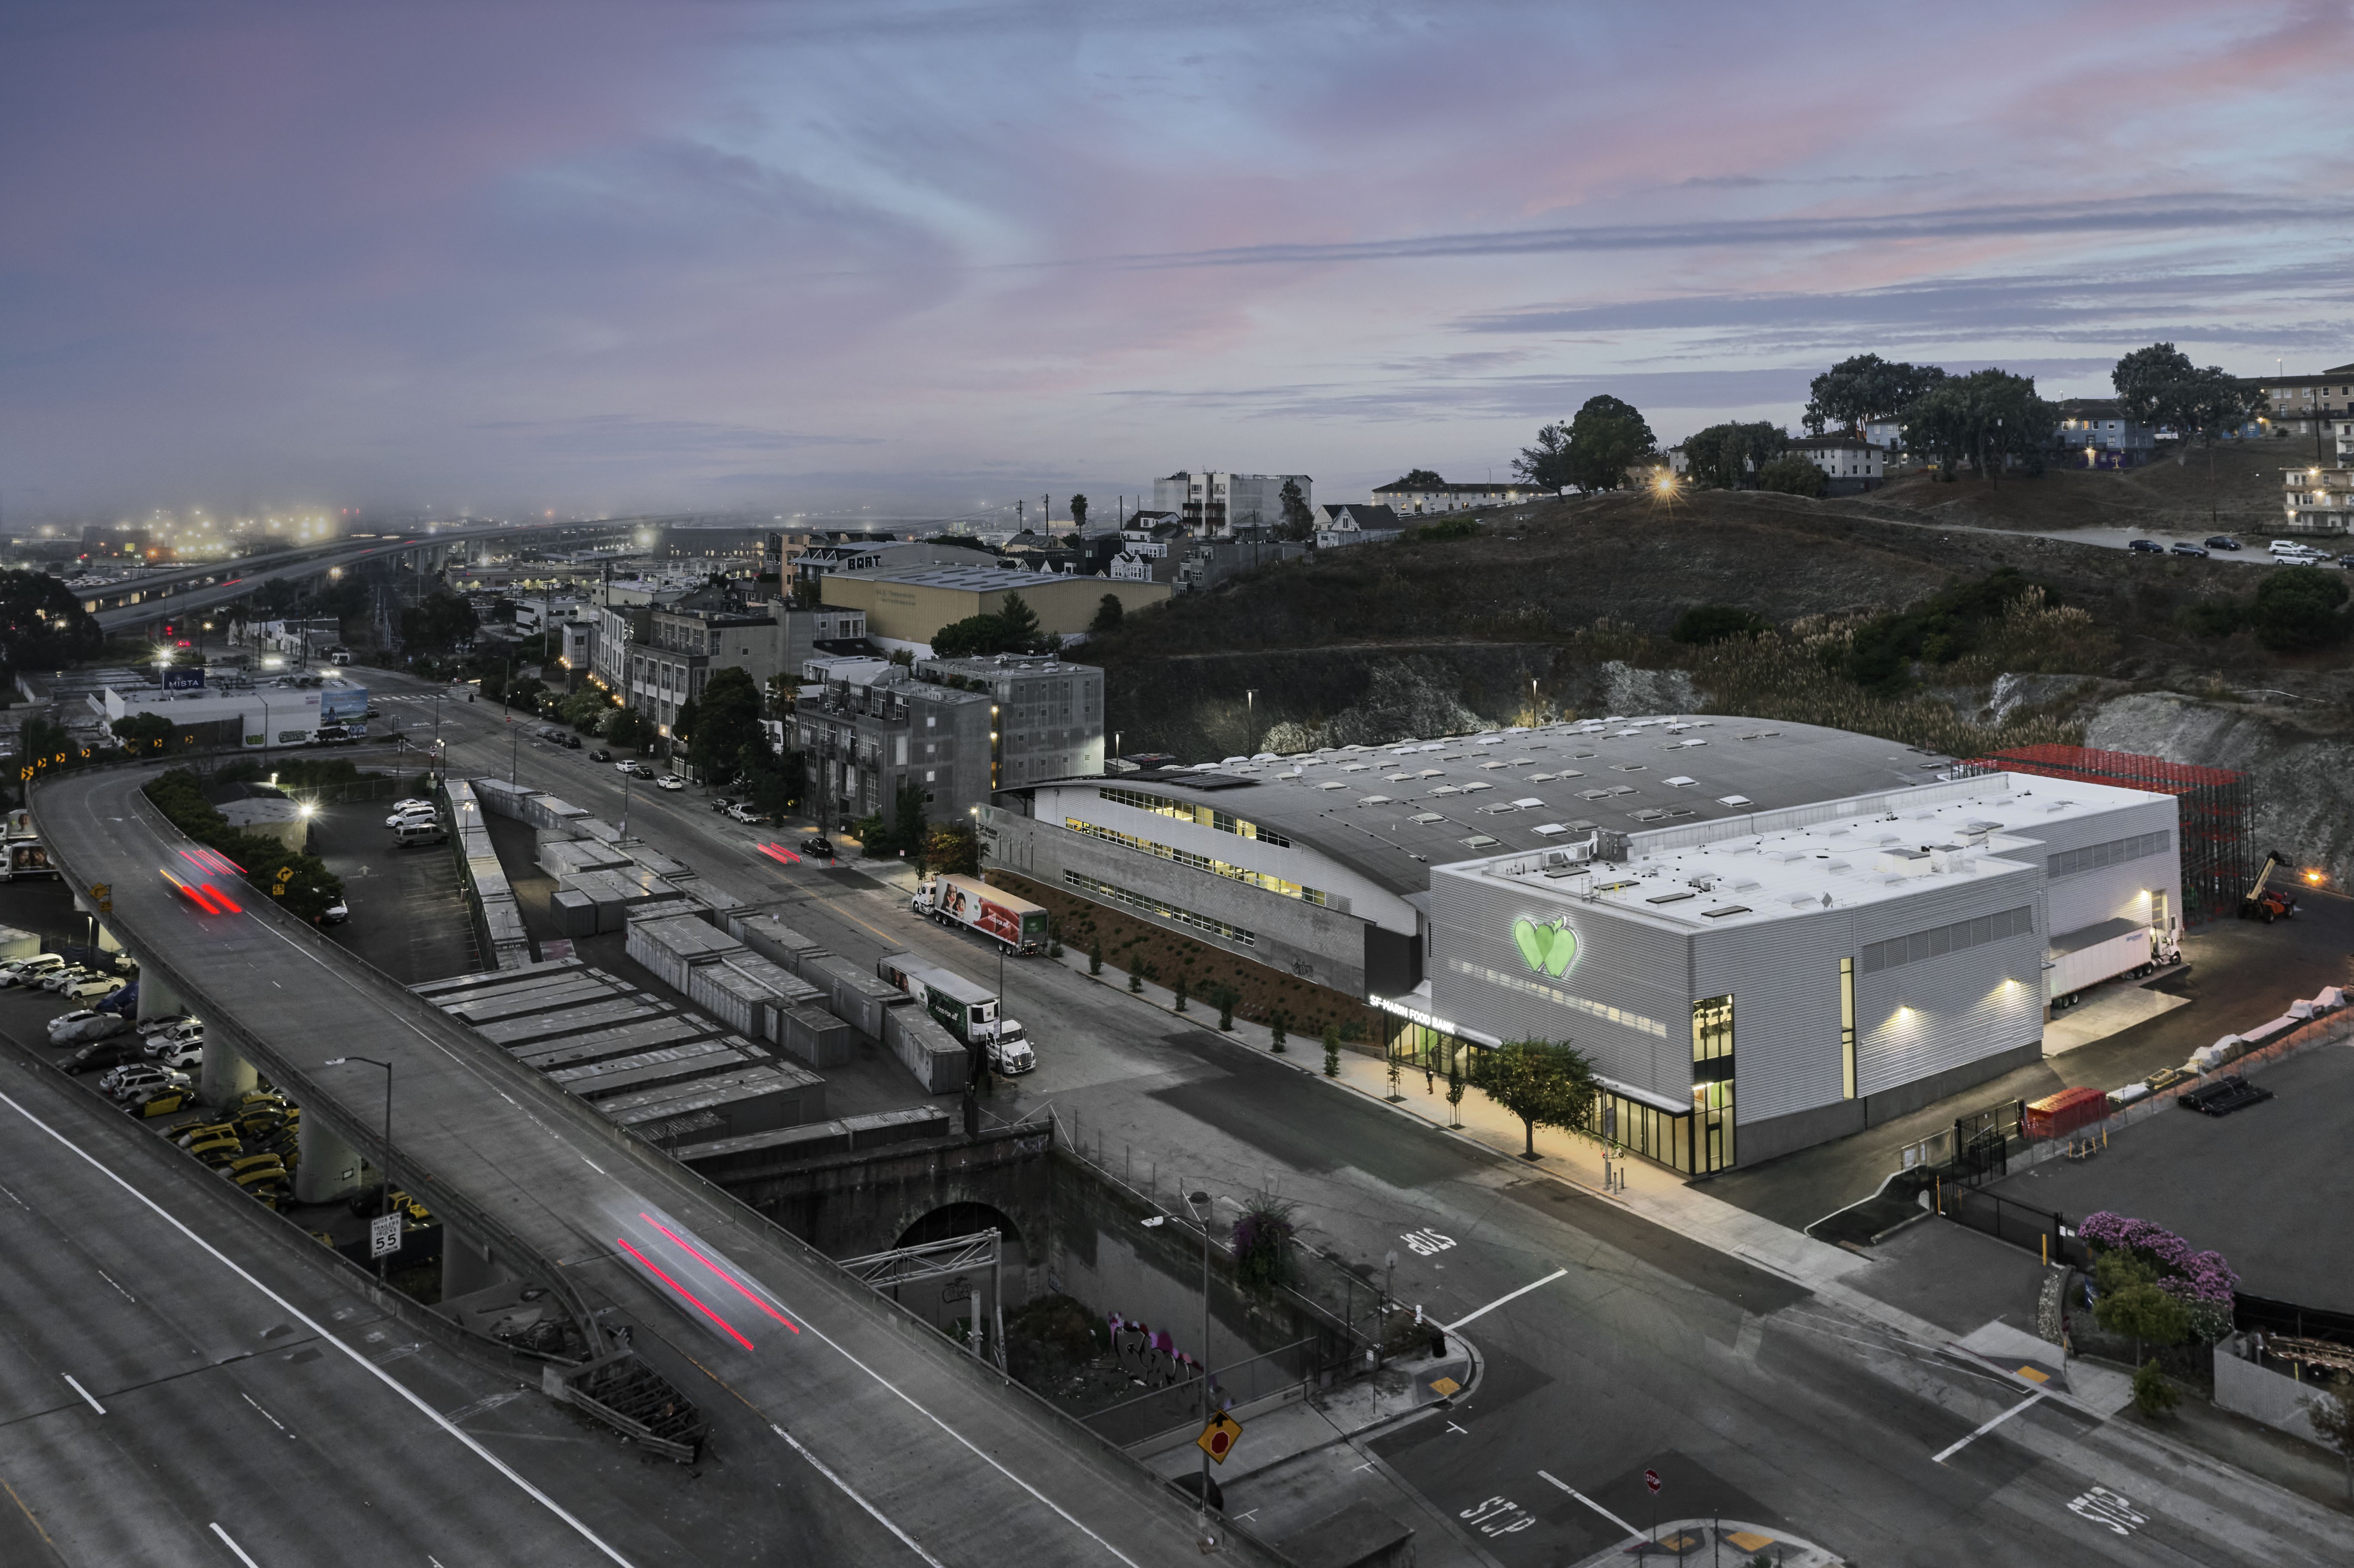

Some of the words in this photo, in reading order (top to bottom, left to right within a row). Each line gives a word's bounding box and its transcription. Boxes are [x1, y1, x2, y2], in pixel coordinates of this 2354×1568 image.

[935, 1005, 945, 1014] FOOD
[1409, 1009, 1431, 1025] FOOD
[1432, 1017, 1455, 1034] BANK
[374, 1220, 399, 1231] TRAILERS
[376, 1227, 397, 1236] TRUCKS
[376, 1233, 397, 1249] 55
[1400, 1228, 1457, 1255] STOP
[374, 1245, 398, 1255] MAXIMUM
[1646, 1473, 1660, 1486] STOP
[1460, 1496, 1536, 1537] STOP
[2066, 1486, 2151, 1535] STOP
